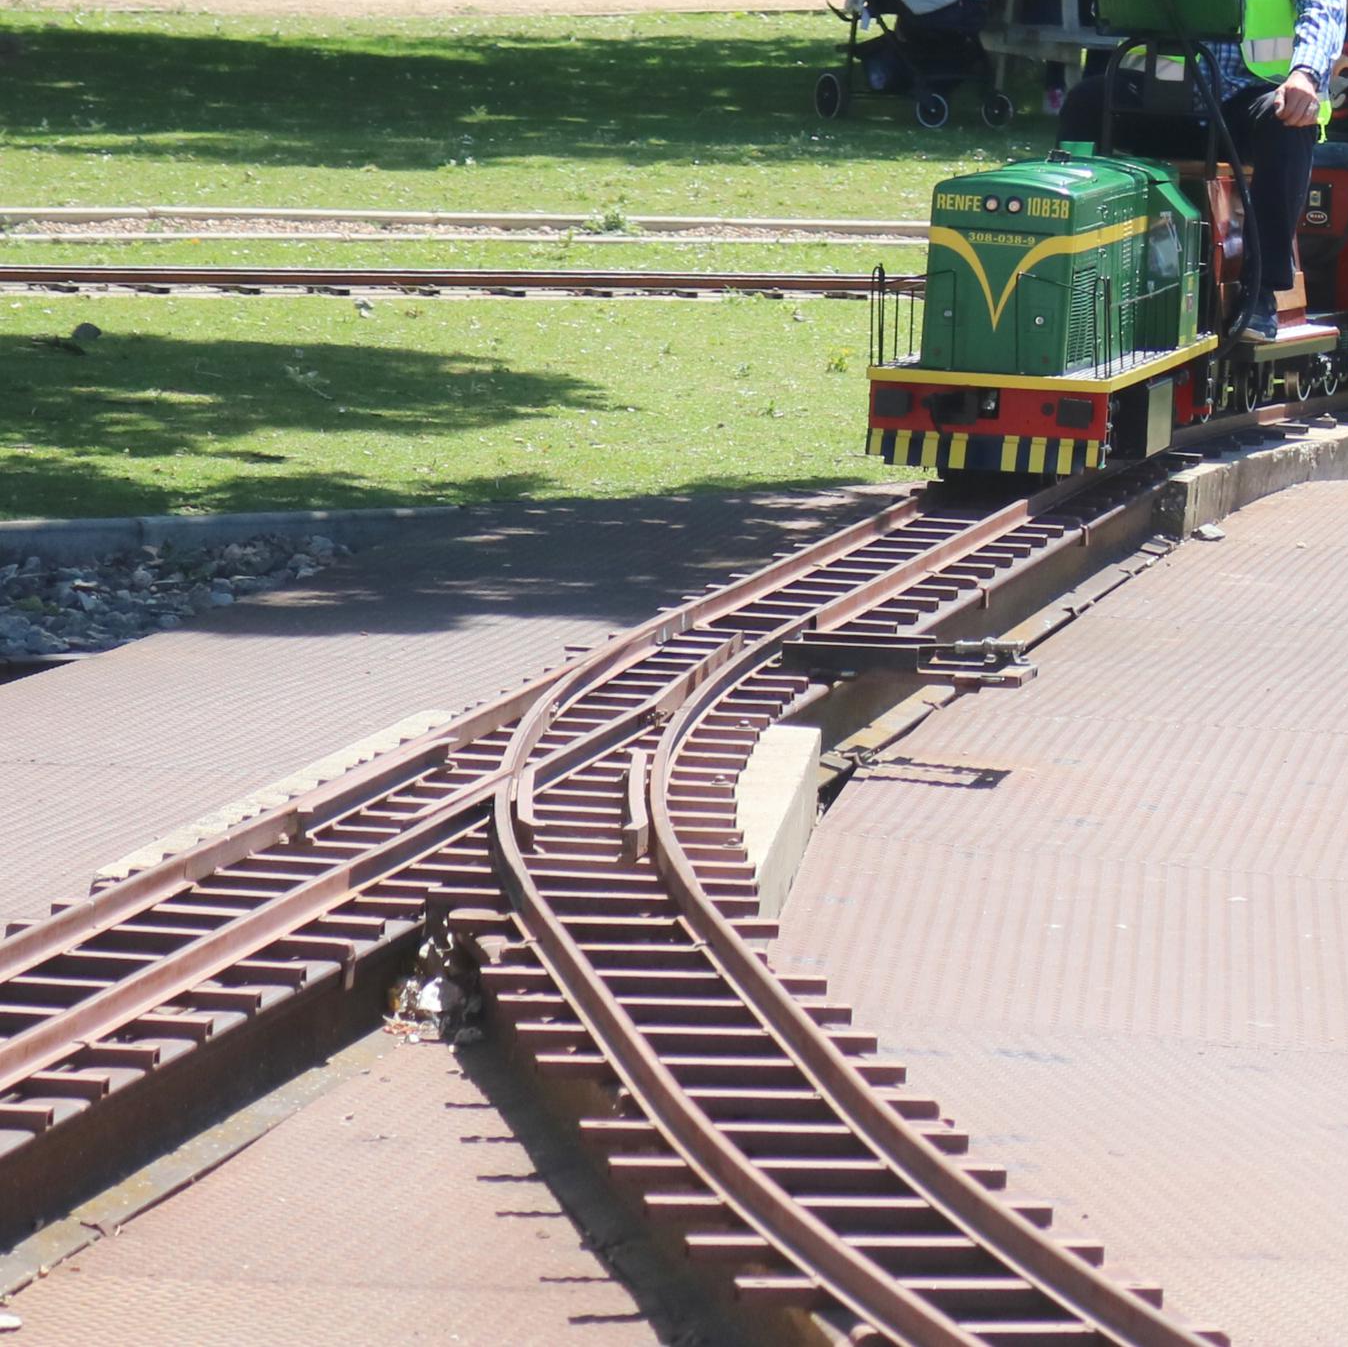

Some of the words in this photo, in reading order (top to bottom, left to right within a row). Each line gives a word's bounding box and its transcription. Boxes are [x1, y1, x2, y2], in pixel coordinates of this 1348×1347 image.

[937, 193, 982, 212] RENFE
[1027, 197, 1069, 219] 10838
[968, 232, 1036, 245] 308-038-9
